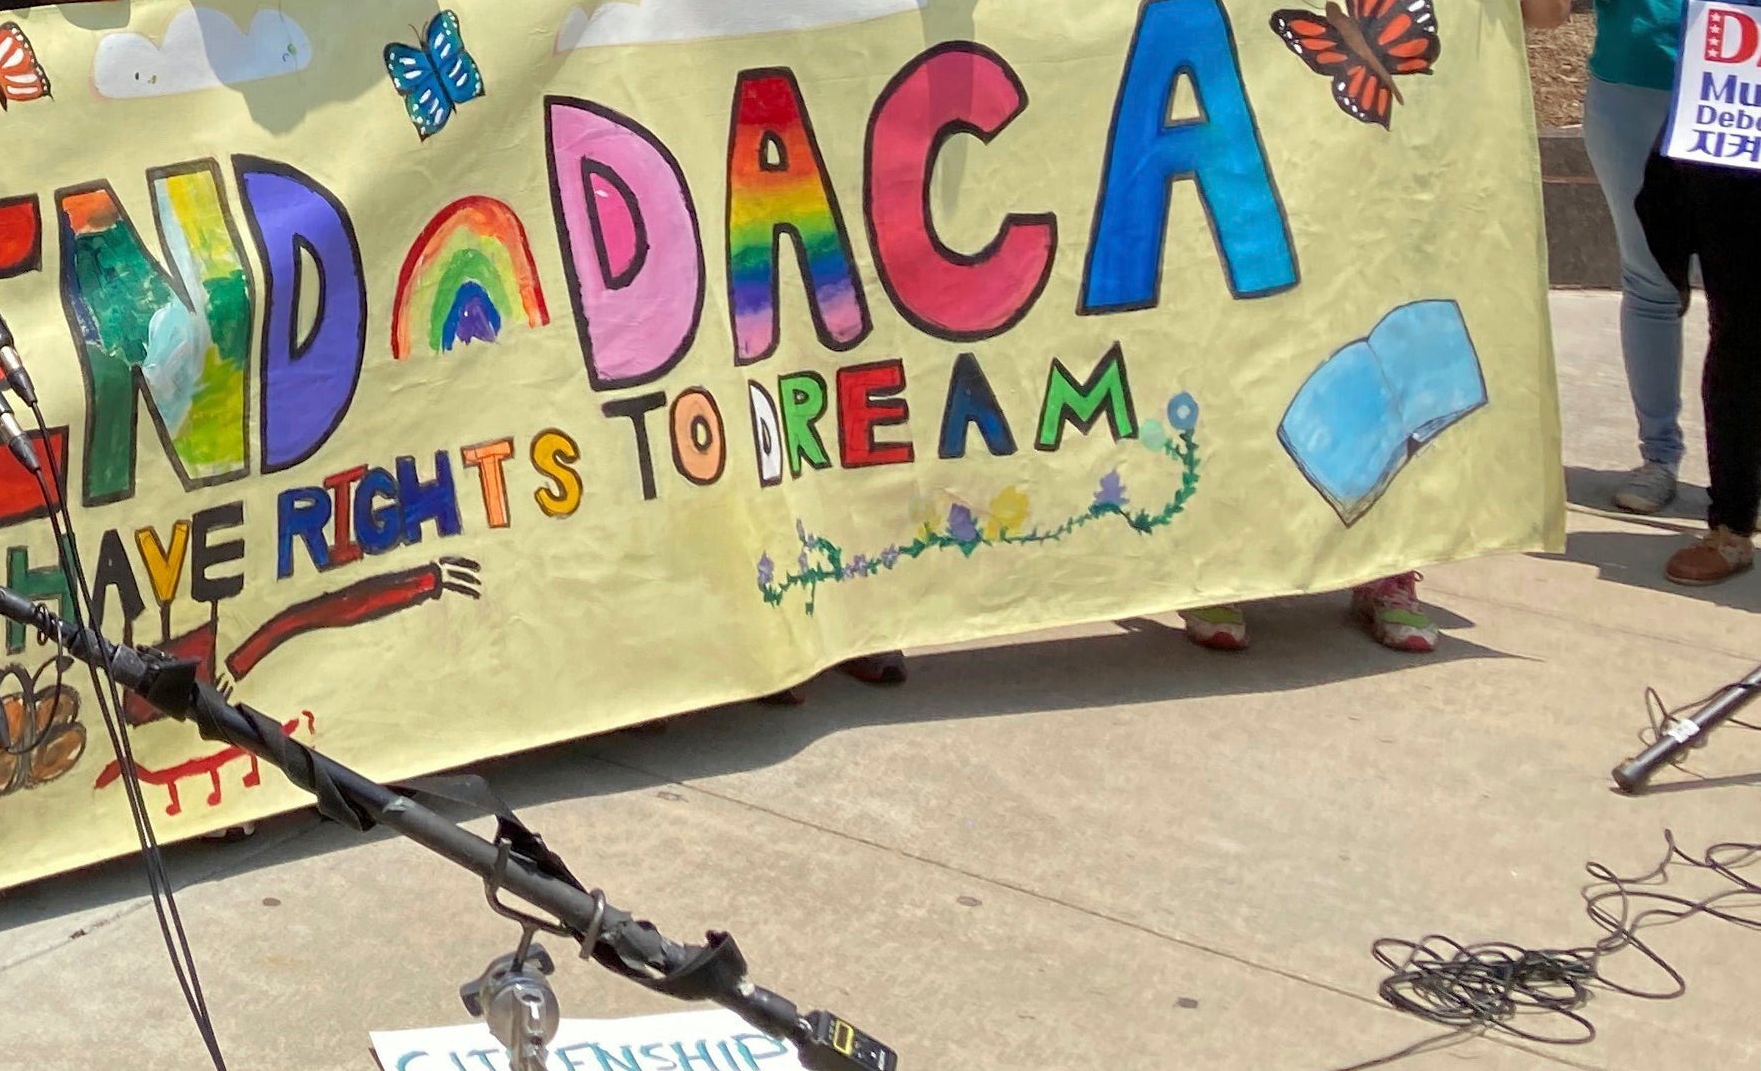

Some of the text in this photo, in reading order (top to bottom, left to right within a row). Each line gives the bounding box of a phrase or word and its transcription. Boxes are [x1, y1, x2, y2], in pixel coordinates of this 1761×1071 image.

[6, 506, 245, 655] HAVE
[276, 428, 585, 581] RIGHTS
[601, 386, 726, 500] TO
[748, 341, 1142, 488] DREAM
